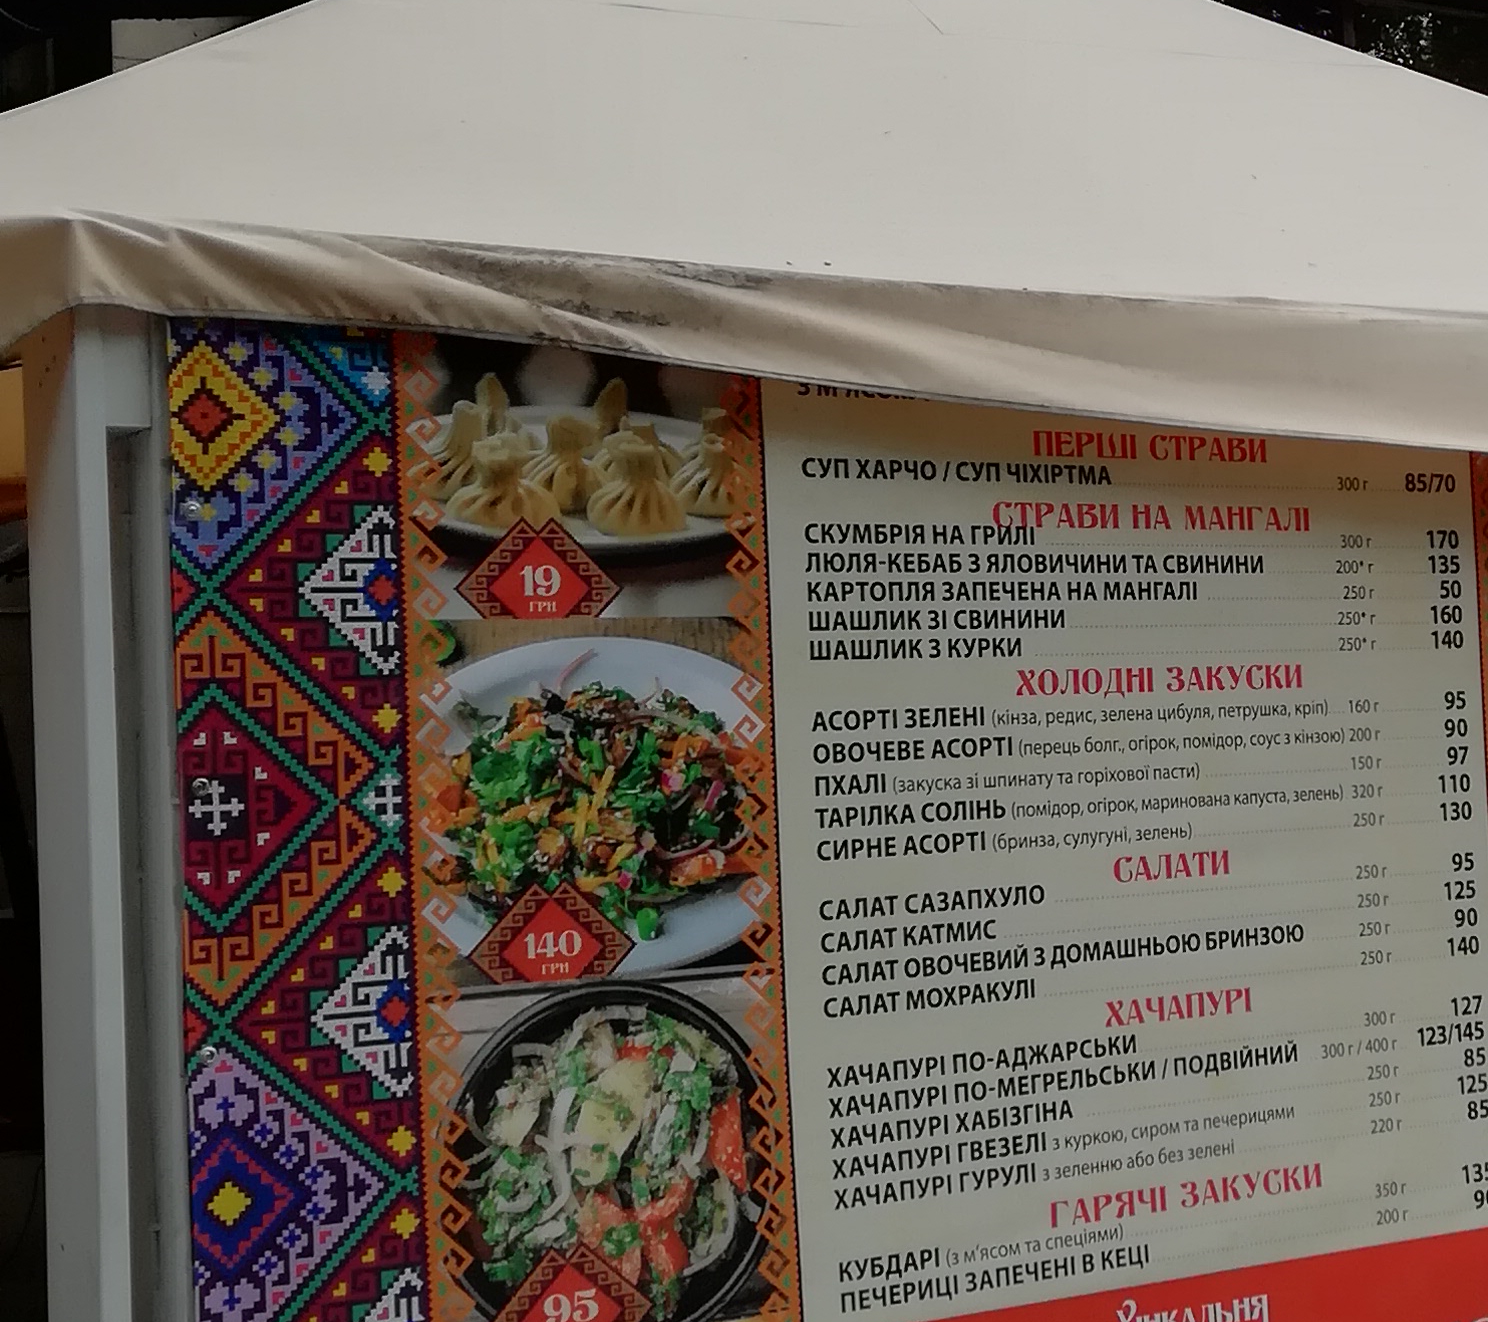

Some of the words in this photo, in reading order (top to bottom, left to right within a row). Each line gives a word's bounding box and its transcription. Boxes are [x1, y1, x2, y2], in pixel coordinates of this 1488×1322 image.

[1032, 430, 1136, 460] ПЕРШІ
[1148, 434, 1266, 463] СТРАВИ
[802, 458, 849, 478] СУП
[856, 459, 936, 480] ХАРЧО
[956, 462, 1000, 482] СУП
[1007, 463, 1112, 485] ЧІХІРТМА
[1405, 473, 1455, 493] 85/70
[992, 501, 1118, 529] СТРАВИ
[1132, 503, 1170, 529] НА
[1185, 506, 1309, 532] МАНГАЛІ
[805, 524, 925, 544] СКУМБРІЯ
[933, 525, 964, 544] НА
[970, 525, 1036, 547] ГРИЛІ
[1427, 530, 1459, 549] 170
[520, 565, 561, 596] 19
[806, 553, 962, 573] ЛЮЛЯ-КЕБАБ
[968, 554, 980, 573] З
[987, 554, 1127, 573] ЯЛОВИЧИНИ
[1132, 555, 1157, 573] ТА
[1163, 555, 1263, 574] СВИНИНИ
[1428, 555, 1460, 574] 135
[530, 601, 556, 612] ГРН
[807, 582, 934, 602] КАРТОПЛЯ
[942, 582, 1061, 601] ЗАПЕЧЕНА
[1067, 582, 1097, 600] НА
[1104, 582, 1197, 600] МАНГАЛІ
[1440, 580, 1461, 599] 50
[809, 610, 921, 631] ШАШЛИК
[928, 610, 946, 629] ЗІ
[954, 610, 1064, 629] СВИНИНИ
[1431, 605, 1462, 624] 160
[810, 639, 922, 660] ШАШЛИК
[929, 639, 941, 658] З
[948, 638, 1021, 658] КУРКИ
[1431, 630, 1463, 649] 140
[1016, 668, 1152, 697] ХОЛОДНІ
[1168, 663, 1302, 693] ЗАКУСКИ
[812, 709, 897, 731] АСОРТІ
[905, 706, 984, 728] ЗЕЛЕНІ
[992, 709, 1041, 727] (кінза,
[1045, 704, 1096, 727] редис,
[1100, 701, 1150, 722] зелена
[1158, 703, 1214, 723] цибуля,
[1219, 705, 1290, 721] петрушка,
[1295, 699, 1328, 719] кріп)
[1445, 691, 1466, 710] 95
[815, 804, 915, 828] ТАРІЛКА
[921, 799, 1005, 822] СОЛІНЬ
[1439, 774, 1470, 793] 110
[817, 837, 896, 861] СИРНЕ
[903, 831, 985, 856] АСОРТІ
[1440, 801, 1471, 821] 130
[1113, 849, 1228, 881] САЛАТИ
[820, 896, 898, 920] САЛАТ
[905, 885, 1044, 914] САЗАПХУЛО
[1452, 852, 1474, 872] 95
[821, 928, 897, 953] САЛАТ
[903, 920, 996, 946] КАТМИС
[1444, 880, 1475, 900] 125
[524, 930, 581, 959] 140
[822, 960, 898, 985] САЛАТ
[904, 948, 1028, 978] ОВОЧЕВИЙ
[1034, 947, 1045, 966] З
[1051, 933, 1200, 969] ДОМАШНЬОЮ
[1206, 924, 1303, 950] БРИНЗОЮ
[1455, 908, 1477, 928] 90
[824, 991, 900, 1017] САЛАТ
[907, 979, 1035, 1010] МОХРАКУЛІ
[1448, 936, 1479, 956] 140
[1106, 988, 1250, 1027] ХАЧАПУРІ
[827, 1056, 945, 1088] ХАЧАПУРІ
[951, 1035, 1138, 1076] ПО-АДЖАРСЬКИ
[1451, 995, 1482, 1016] 127
[829, 1085, 946, 1118] ХАЧАПУРІ
[954, 1060, 1155, 1106] ПО-МЕГРЕЛЬСЬКИ
[1174, 1040, 1297, 1077] ПОДВІЙНИЙ
[1418, 1021, 1484, 1046] 123/145
[831, 1115, 948, 1149] ХАЧАПУРІ
[956, 1100, 1073, 1133] ХАБІЗГІНА
[1464, 1047, 1485, 1067] 85
[833, 1145, 950, 1179] ХАЧАПУРІ
[958, 1132, 1046, 1162] ГВЕЗЕЛІ
[1458, 1073, 1487, 1094] 125
[835, 1175, 951, 1209] ХАЧАПУРІ
[960, 1163, 1035, 1192] ГУРУЛІ
[1468, 1099, 1488, 1120] 85
[1050, 1185, 1166, 1227] ГАРЯЧІ
[1182, 1162, 1321, 1206] ЗАКУСКИ
[839, 1247, 939, 1282] КУБДАРІ
[841, 1275, 958, 1313] ПЕЧЕРИЦІ
[965, 1256, 1075, 1292] ЗАПЕЧЕНІ
[1083, 1254, 1094, 1273] В
[1102, 1244, 1149, 1270] КЕЦІ
